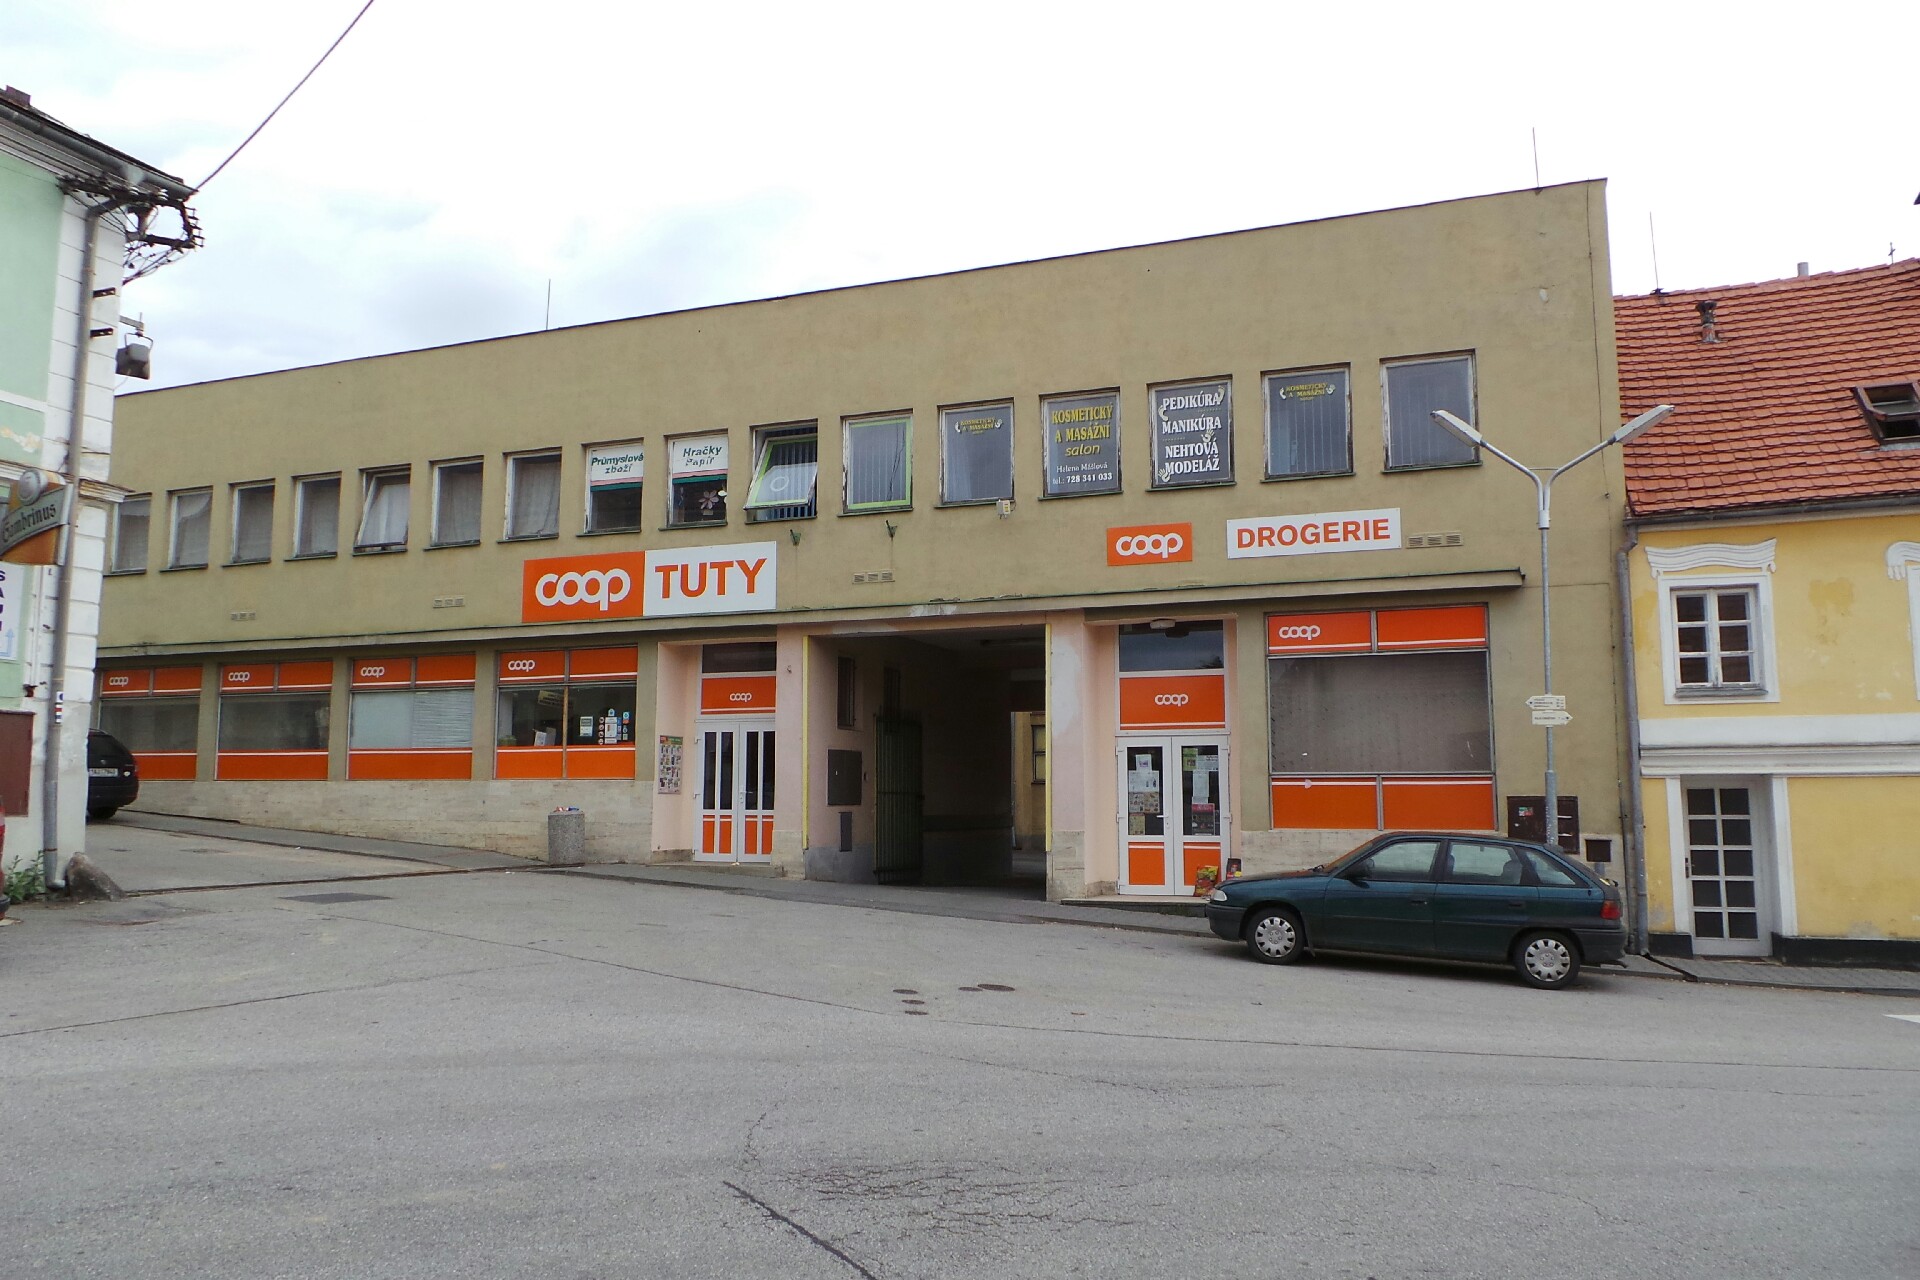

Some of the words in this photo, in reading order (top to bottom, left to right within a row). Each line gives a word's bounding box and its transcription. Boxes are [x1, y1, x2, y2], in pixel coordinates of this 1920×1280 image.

[1162, 391, 1220, 411] PEDIKÚRA
[1051, 402, 1114, 424] KOSMETICKÝ
[1055, 430, 1062, 443] A
[1066, 421, 1111, 442] MASÁŽNÍ
[1162, 414, 1222, 434] MANIKÚRA
[683, 445, 722, 458] Hračky
[1065, 444, 1100, 457] salon
[1165, 437, 1219, 459] NEHTOVÁ
[591, 452, 644, 467] Průmyslová
[1165, 455, 1220, 475] MODELÁŽ
[604, 463, 632, 475] zboží
[1066, 474, 1081, 484] 728
[1082, 473, 1097, 482] 341
[1098, 472, 1113, 481] 033
[1237, 519, 1389, 549] DROGERIE
[1115, 532, 1184, 559] coop
[655, 557, 767, 599] TUTY
[535, 568, 631, 611] coop
[1278, 624, 1321, 641] coop
[360, 665, 386, 679] coop
[507, 659, 536, 673] coop
[227, 670, 251, 683] coop
[729, 691, 753, 704] coop
[1154, 692, 1189, 707] coop
